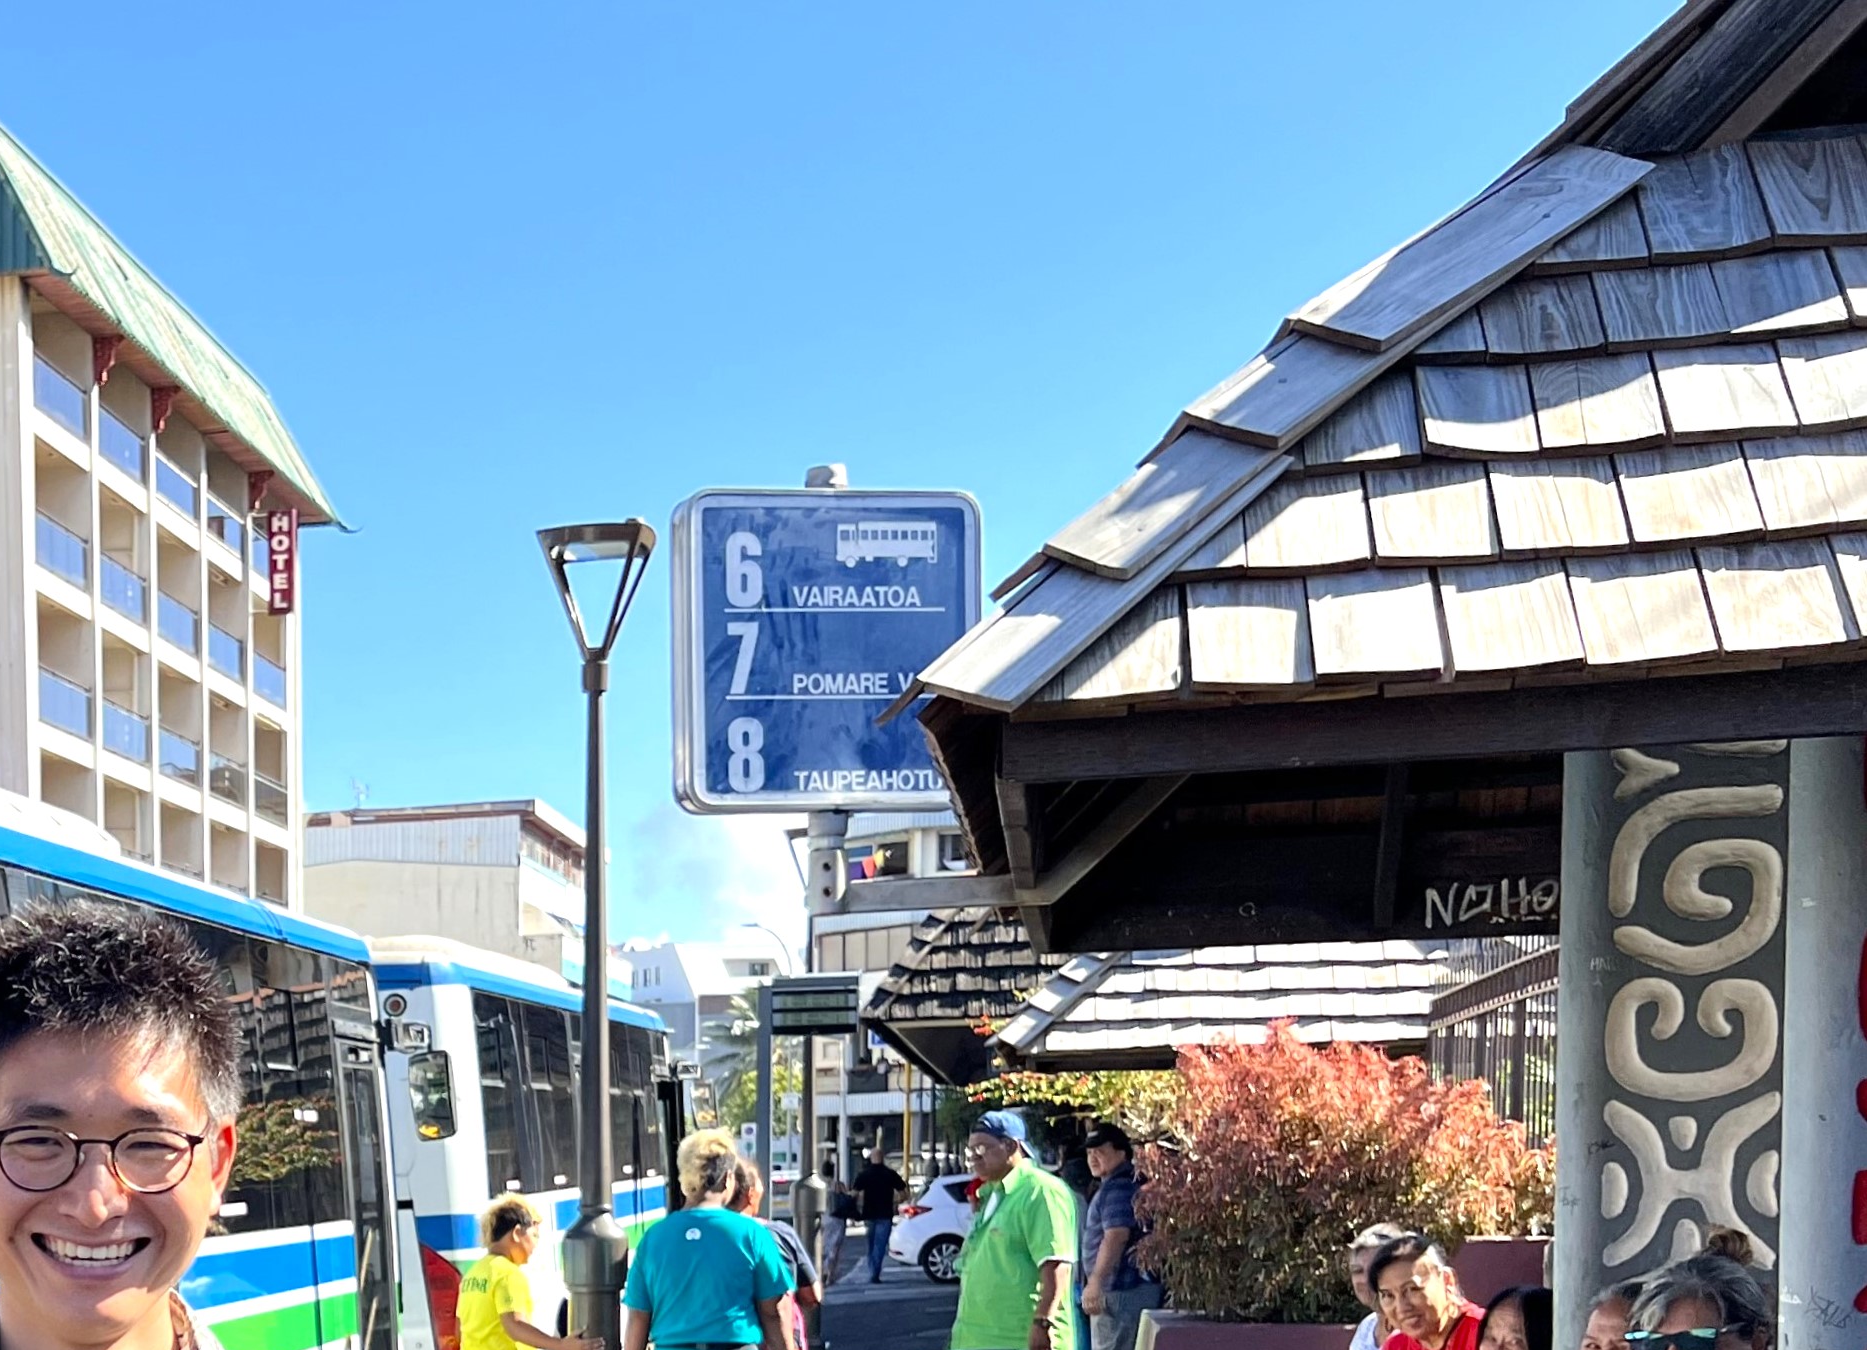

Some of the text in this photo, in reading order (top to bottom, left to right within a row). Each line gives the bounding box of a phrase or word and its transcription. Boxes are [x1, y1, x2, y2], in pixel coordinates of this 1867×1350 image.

[270, 514, 290, 609] HOTEL
[724, 530, 922, 608] 6 VAIRAATOA
[726, 621, 760, 695] 7
[792, 672, 890, 695] POMARE
[727, 716, 766, 794] 8
